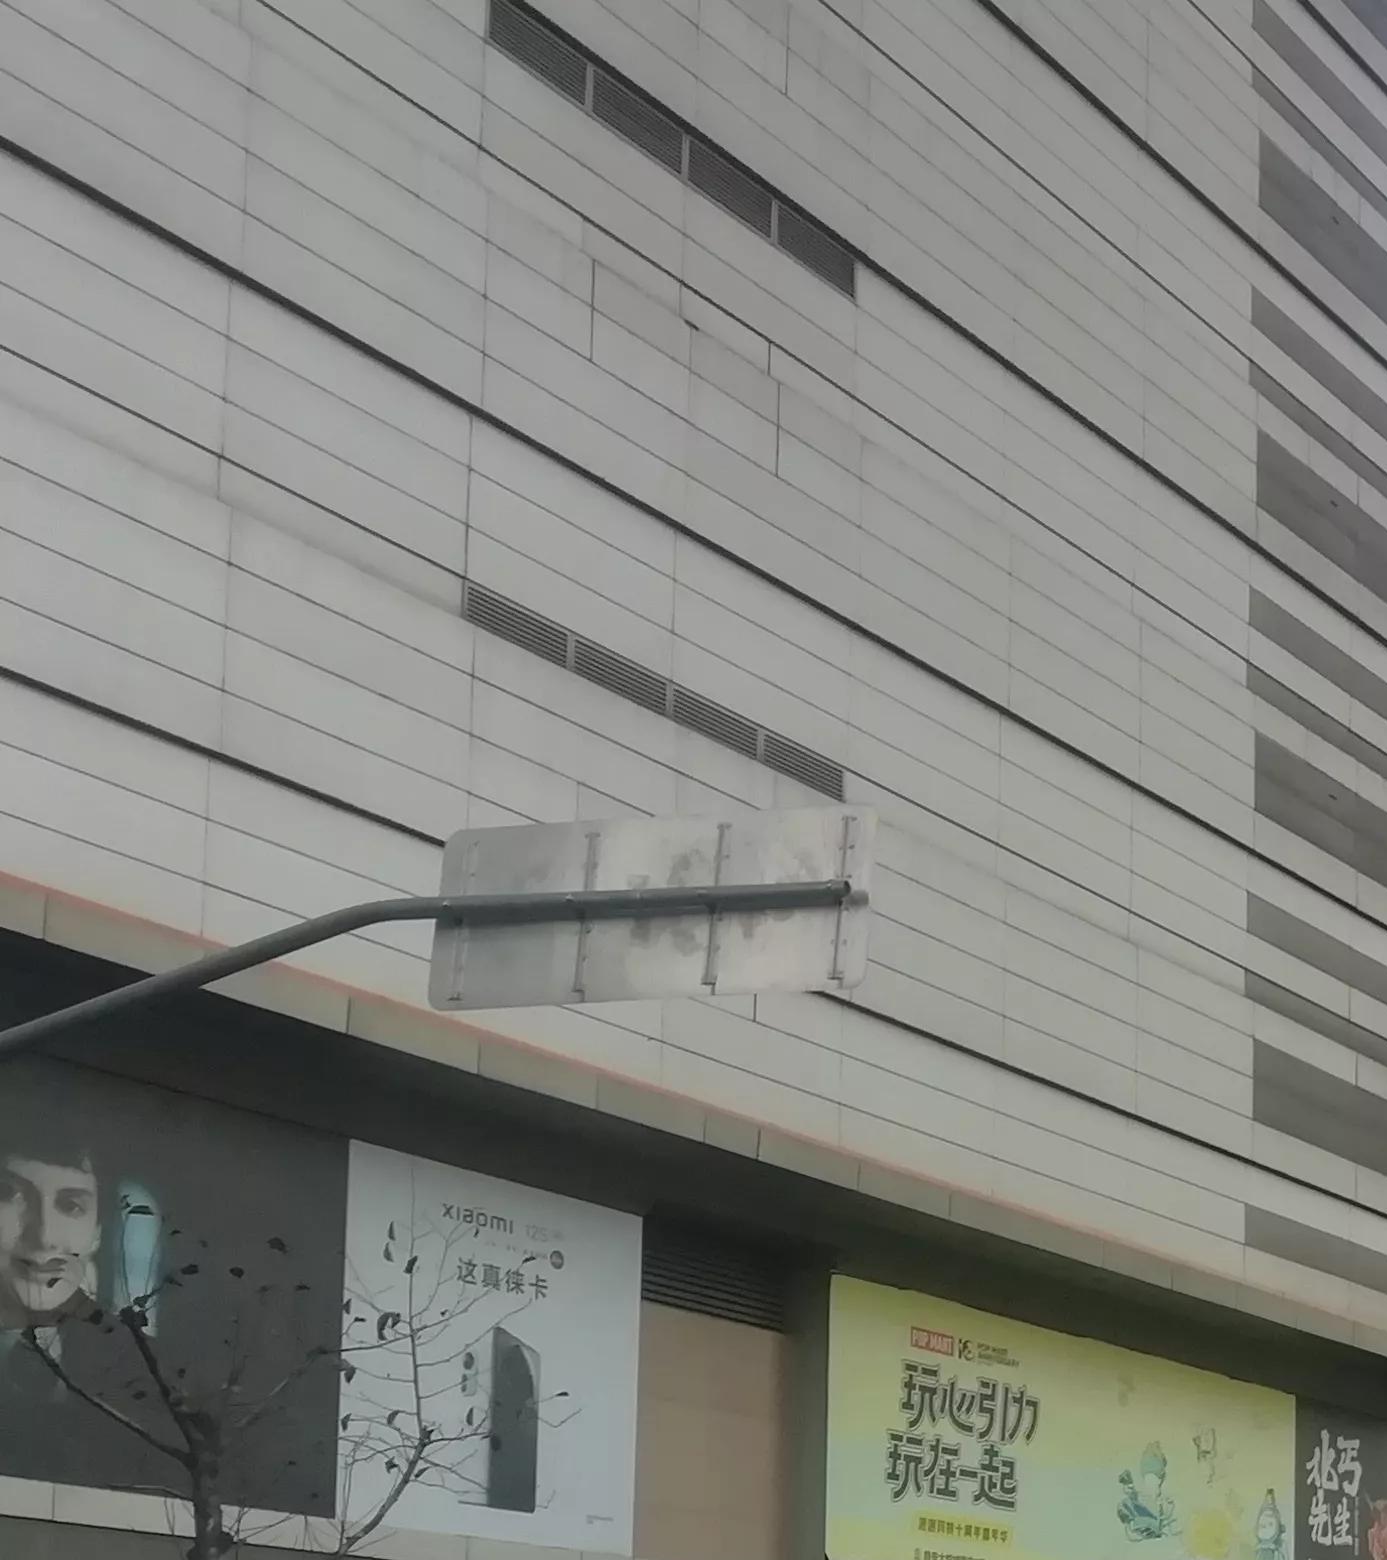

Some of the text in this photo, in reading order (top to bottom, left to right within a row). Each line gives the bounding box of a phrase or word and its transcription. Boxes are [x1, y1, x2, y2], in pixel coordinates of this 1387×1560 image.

[442, 1203, 513, 1234] xiaomi
[457, 1257, 548, 1300] 这真徕卡
[900, 1359, 1040, 1445] 玩心引力
[886, 1430, 1018, 1511] 玩在一起
[1308, 1488, 1353, 1546] 先生
